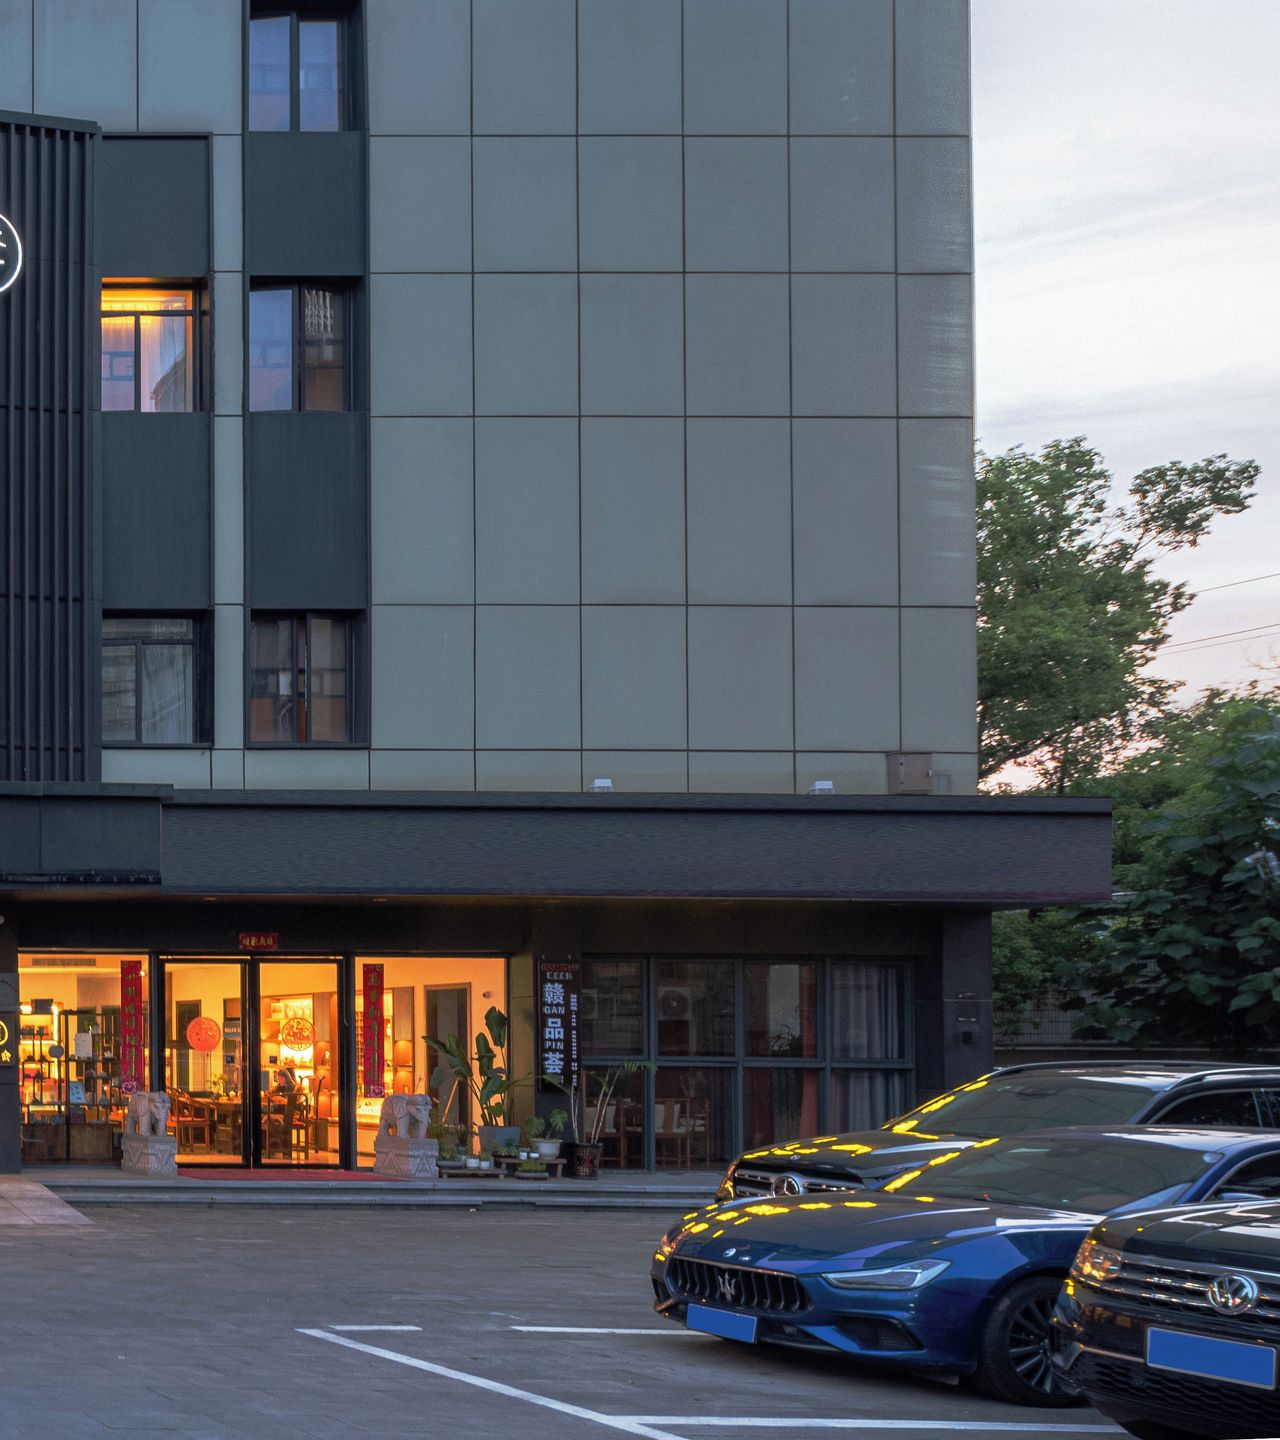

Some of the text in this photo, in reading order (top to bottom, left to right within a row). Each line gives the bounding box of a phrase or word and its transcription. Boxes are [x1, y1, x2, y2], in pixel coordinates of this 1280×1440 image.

[543, 1006, 565, 1015] GAN
[545, 1018, 564, 1040] 品
[544, 1040, 564, 1050] PIN
